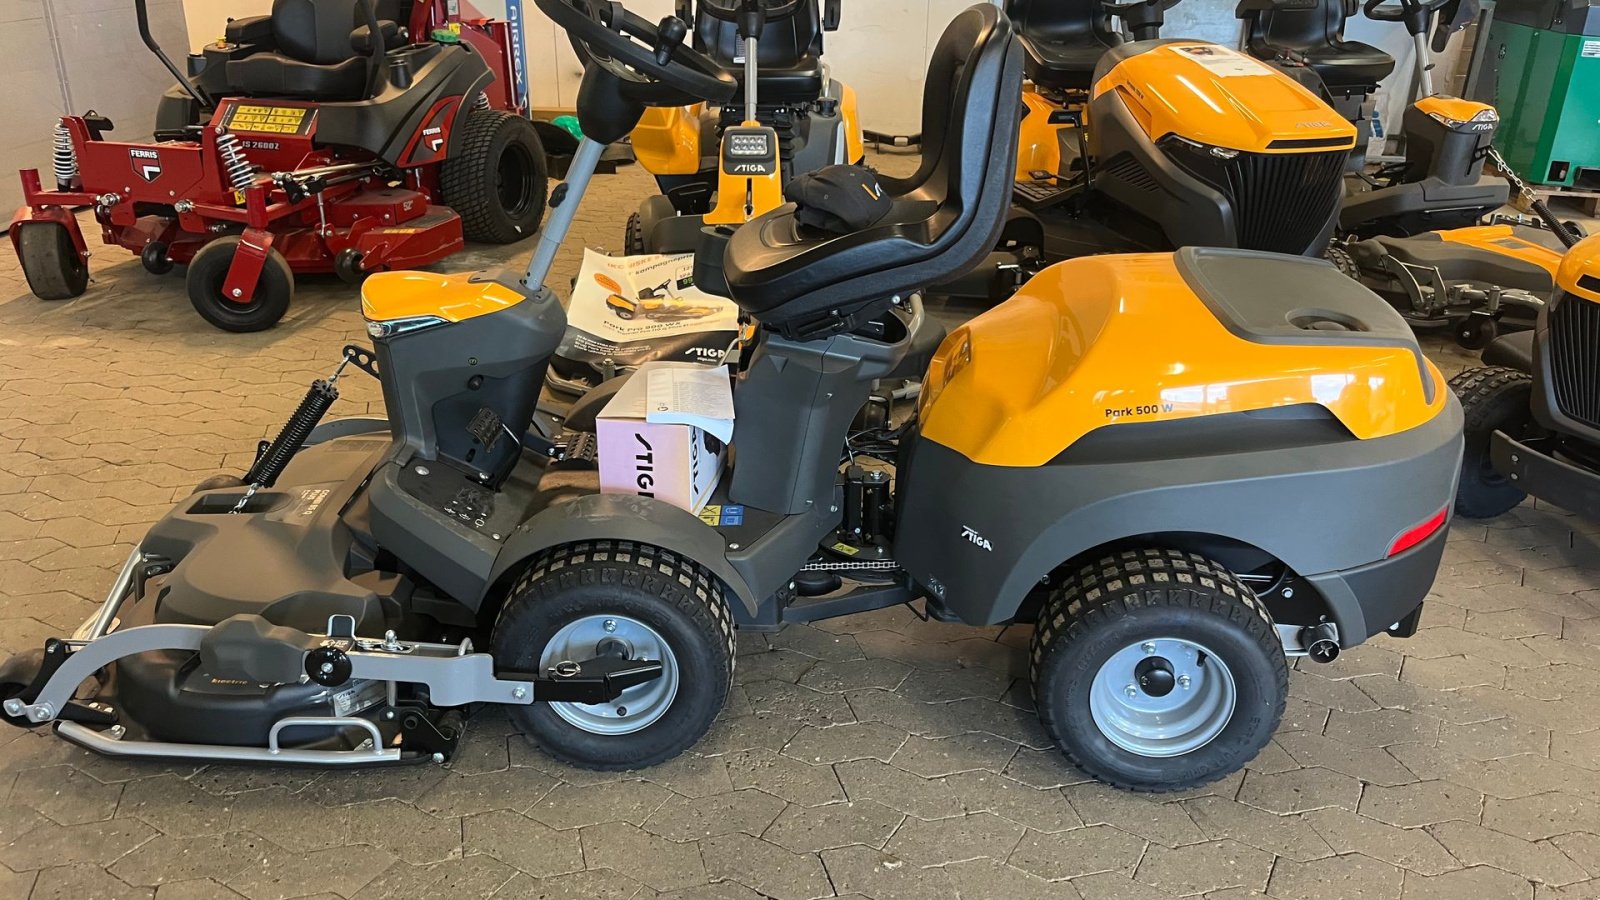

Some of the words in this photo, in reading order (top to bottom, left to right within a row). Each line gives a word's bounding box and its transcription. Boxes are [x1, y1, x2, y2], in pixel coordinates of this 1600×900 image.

[510, 5, 522, 85] AIRREX
[422, 127, 441, 136] FERRIS
[1471, 123, 1493, 131] STIGA
[252, 141, 280, 150] 2600Z
[130, 149, 158, 159] FERRIS
[734, 164, 766, 172] STIGA
[603, 320, 624, 332] Park
[1105, 407, 1133, 417] Park
[1136, 404, 1159, 415] 500
[1161, 403, 1173, 413] W
[961, 530, 992, 552] STIGA
